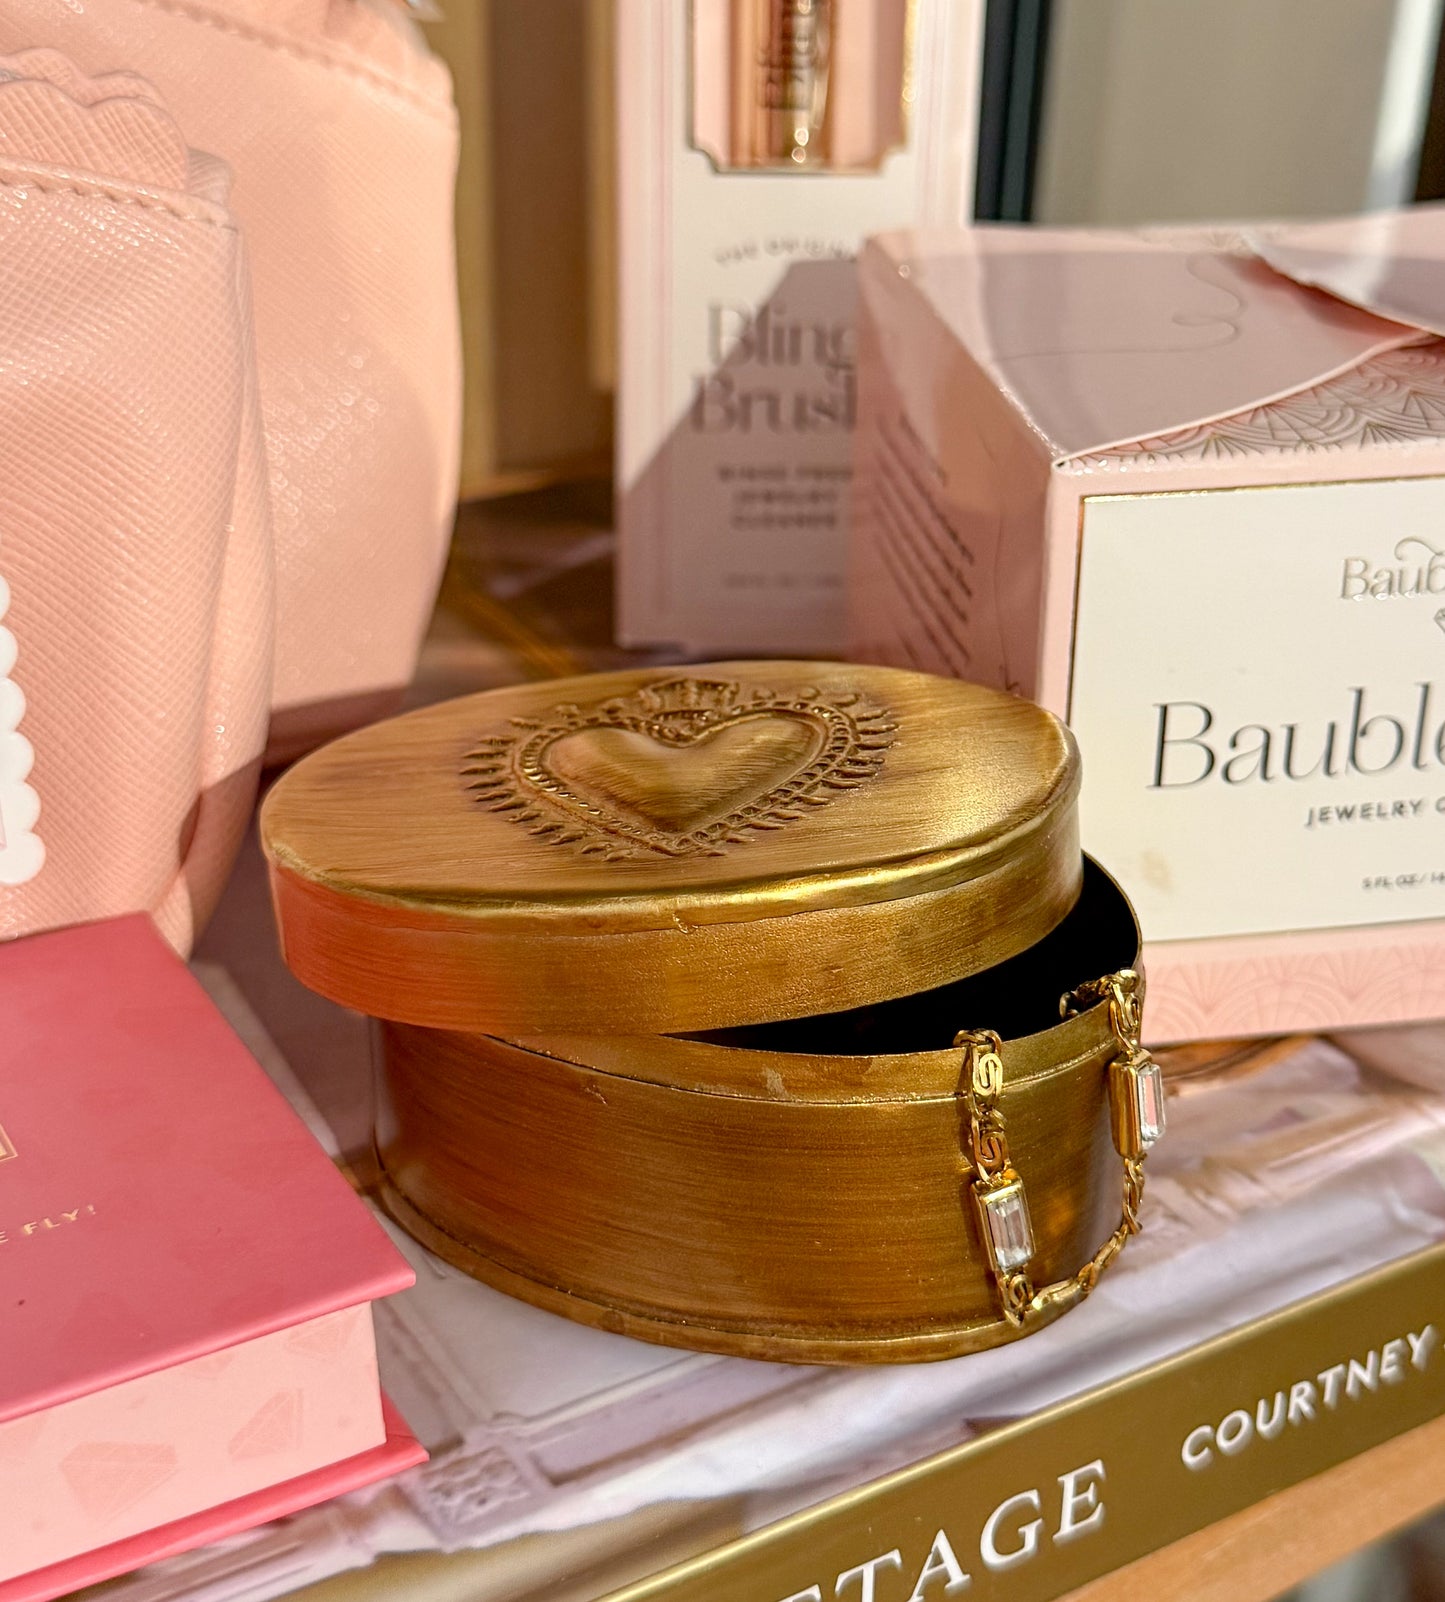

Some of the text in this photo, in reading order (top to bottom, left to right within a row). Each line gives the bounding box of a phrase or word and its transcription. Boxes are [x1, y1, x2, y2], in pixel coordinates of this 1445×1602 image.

[1304, 799, 1423, 829] JEWELRY
[23, 1204, 96, 1234] FLY!
[775, 1324, 1437, 1602] TAGE COURTNEY
